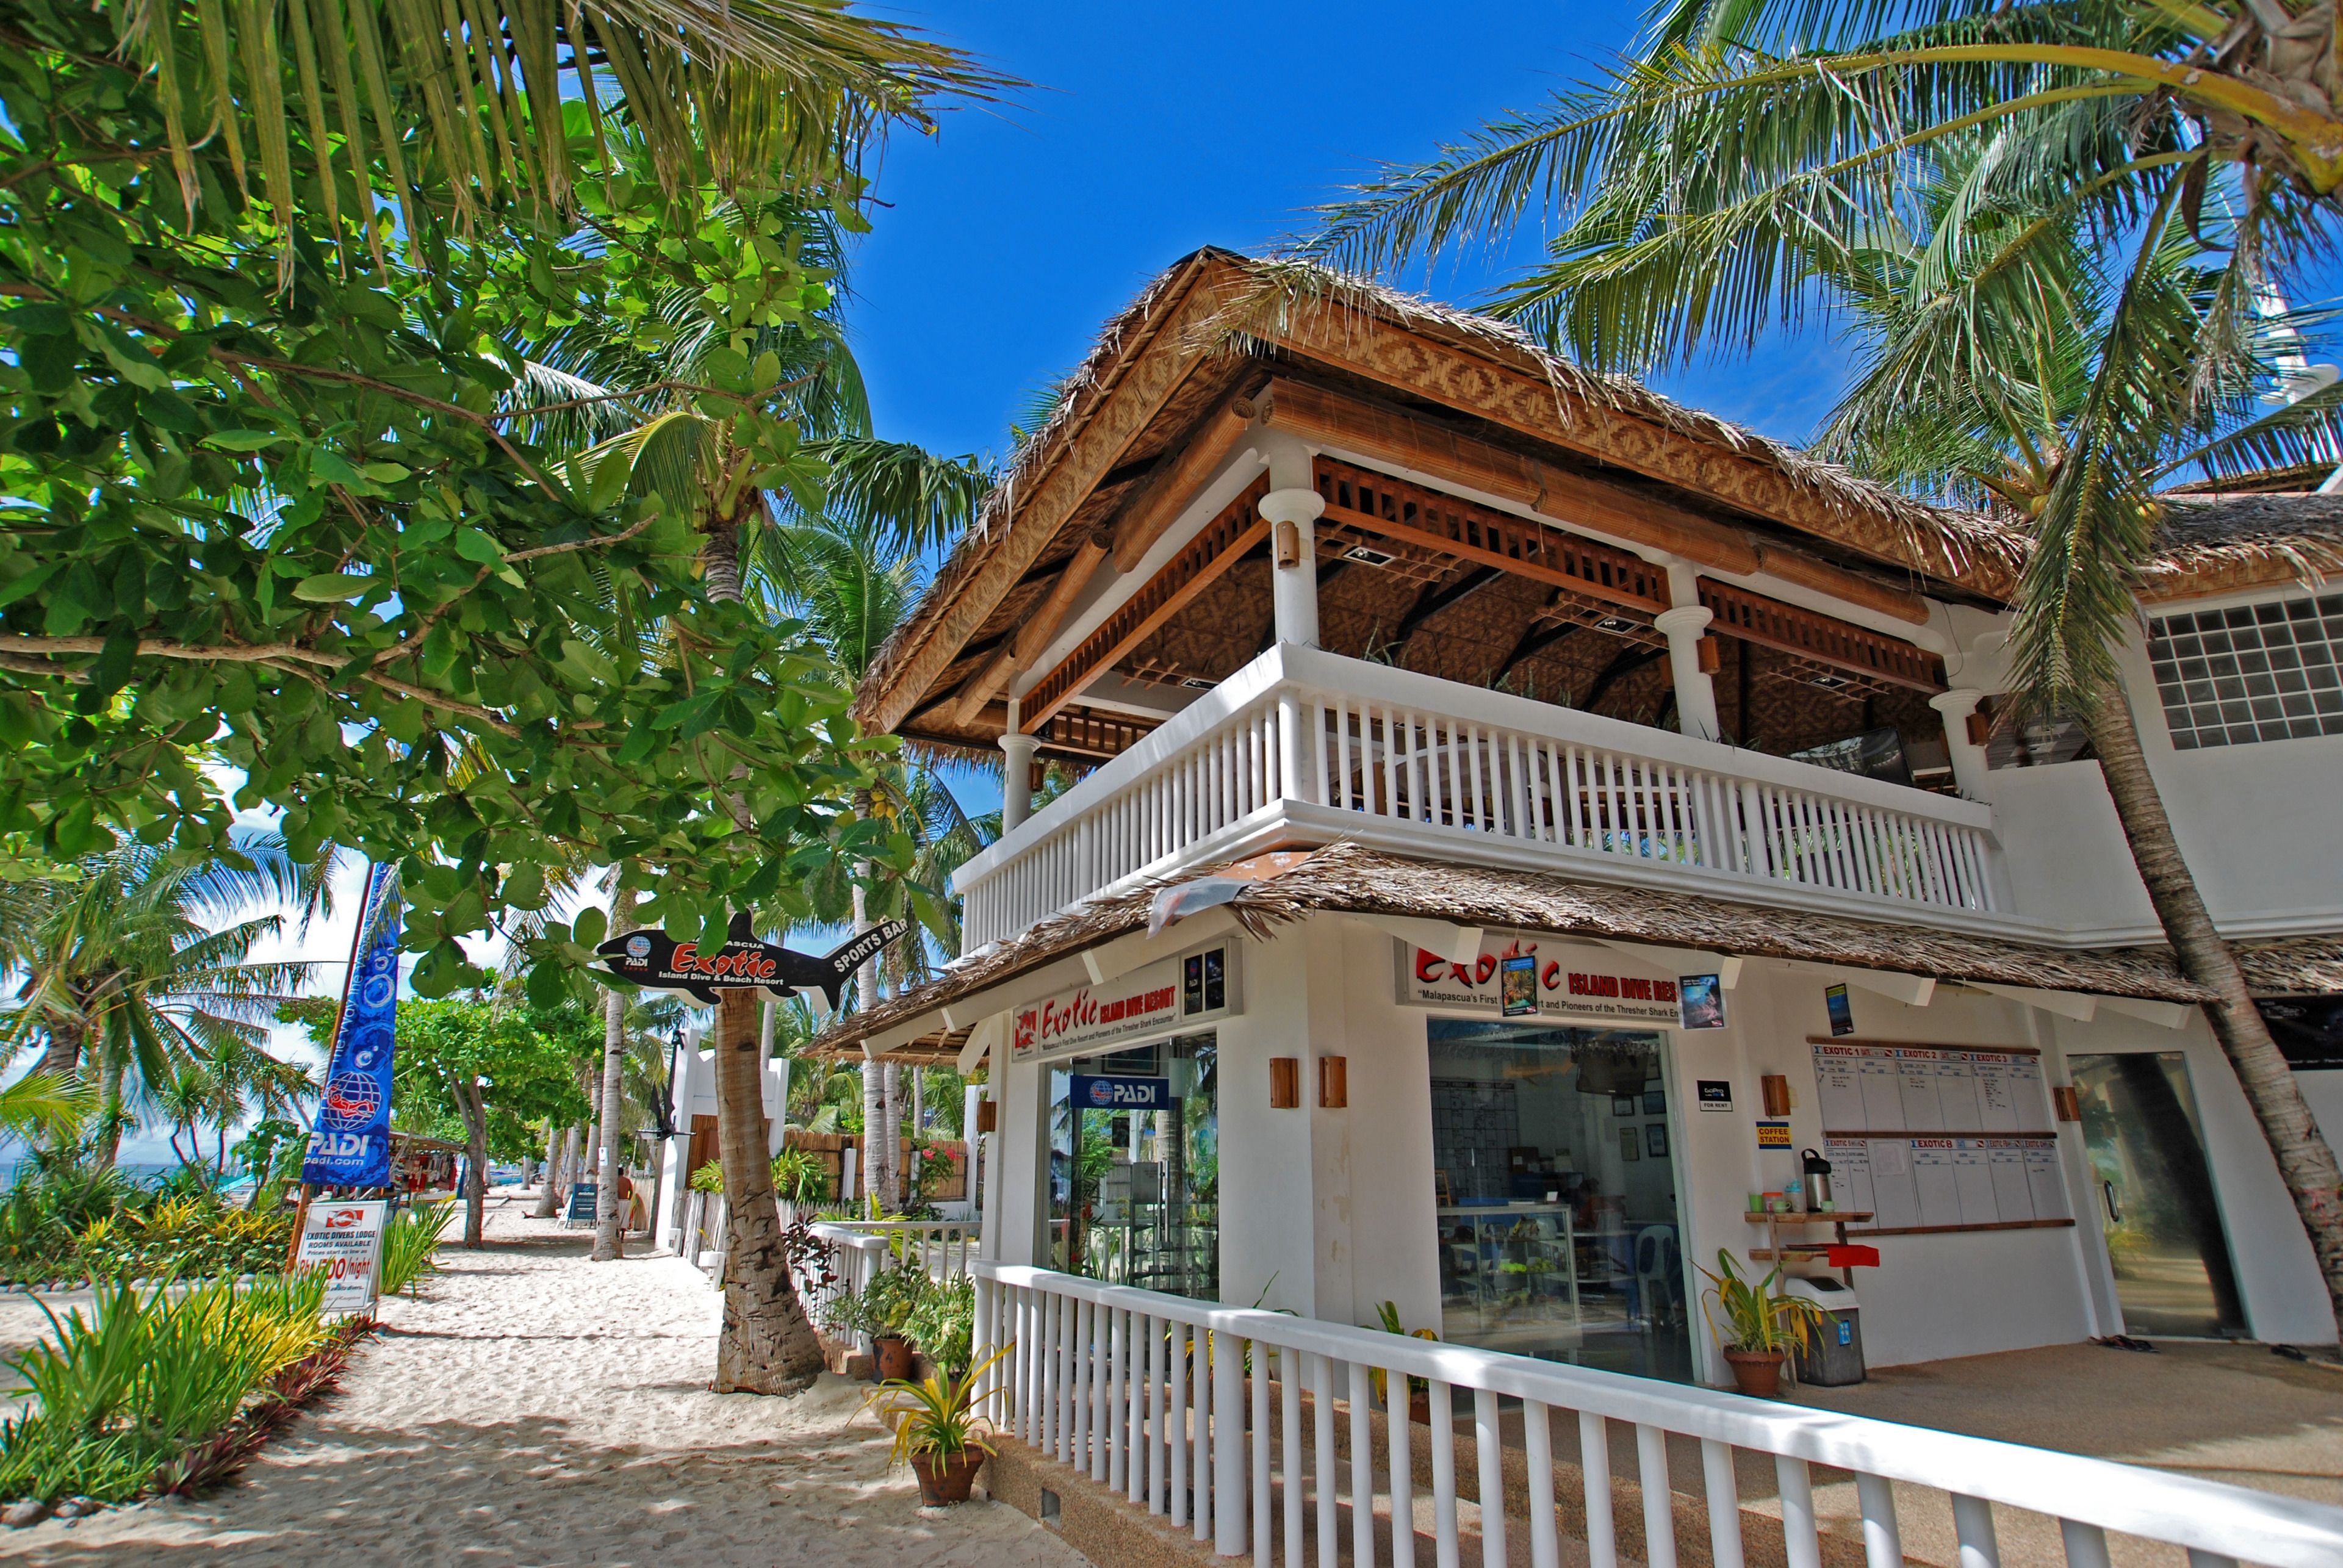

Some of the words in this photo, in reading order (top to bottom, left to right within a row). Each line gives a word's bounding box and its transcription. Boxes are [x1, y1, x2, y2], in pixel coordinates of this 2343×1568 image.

[834, 933, 882, 973] SPORTS
[882, 918, 908, 940] BAR
[625, 957, 648, 966] PADI
[672, 943, 776, 978] Exotic
[659, 971, 688, 979] Island
[1568, 973, 1618, 998] ISLAND
[1621, 977, 1652, 1000] DIVE
[1480, 994, 1498, 1004] First
[1042, 988, 1097, 1039] Exotic
[1100, 1001, 1125, 1024] ISLAND
[1126, 995, 1143, 1018] DIVE
[1144, 985, 1176, 1013] RESORT
[1546, 1001, 1560, 1009] and
[1561, 1001, 1593, 1012] Pioneers
[1595, 1002, 1603, 1012] of
[1604, 1003, 1615, 1013] the
[1616, 1004, 1647, 1016] Thresher
[1649, 1007, 1668, 1016] Shark
[1122, 1023, 1139, 1032] Thresher
[1140, 1019, 1151, 1029] Shark
[1823, 1046, 1853, 1056] EXOTIC
[1903, 1050, 1930, 1059] EXOTIC
[1114, 1084, 1156, 1102] PADI
[306, 1131, 370, 1156] PADI
[303, 1156, 364, 1165] padi.com
